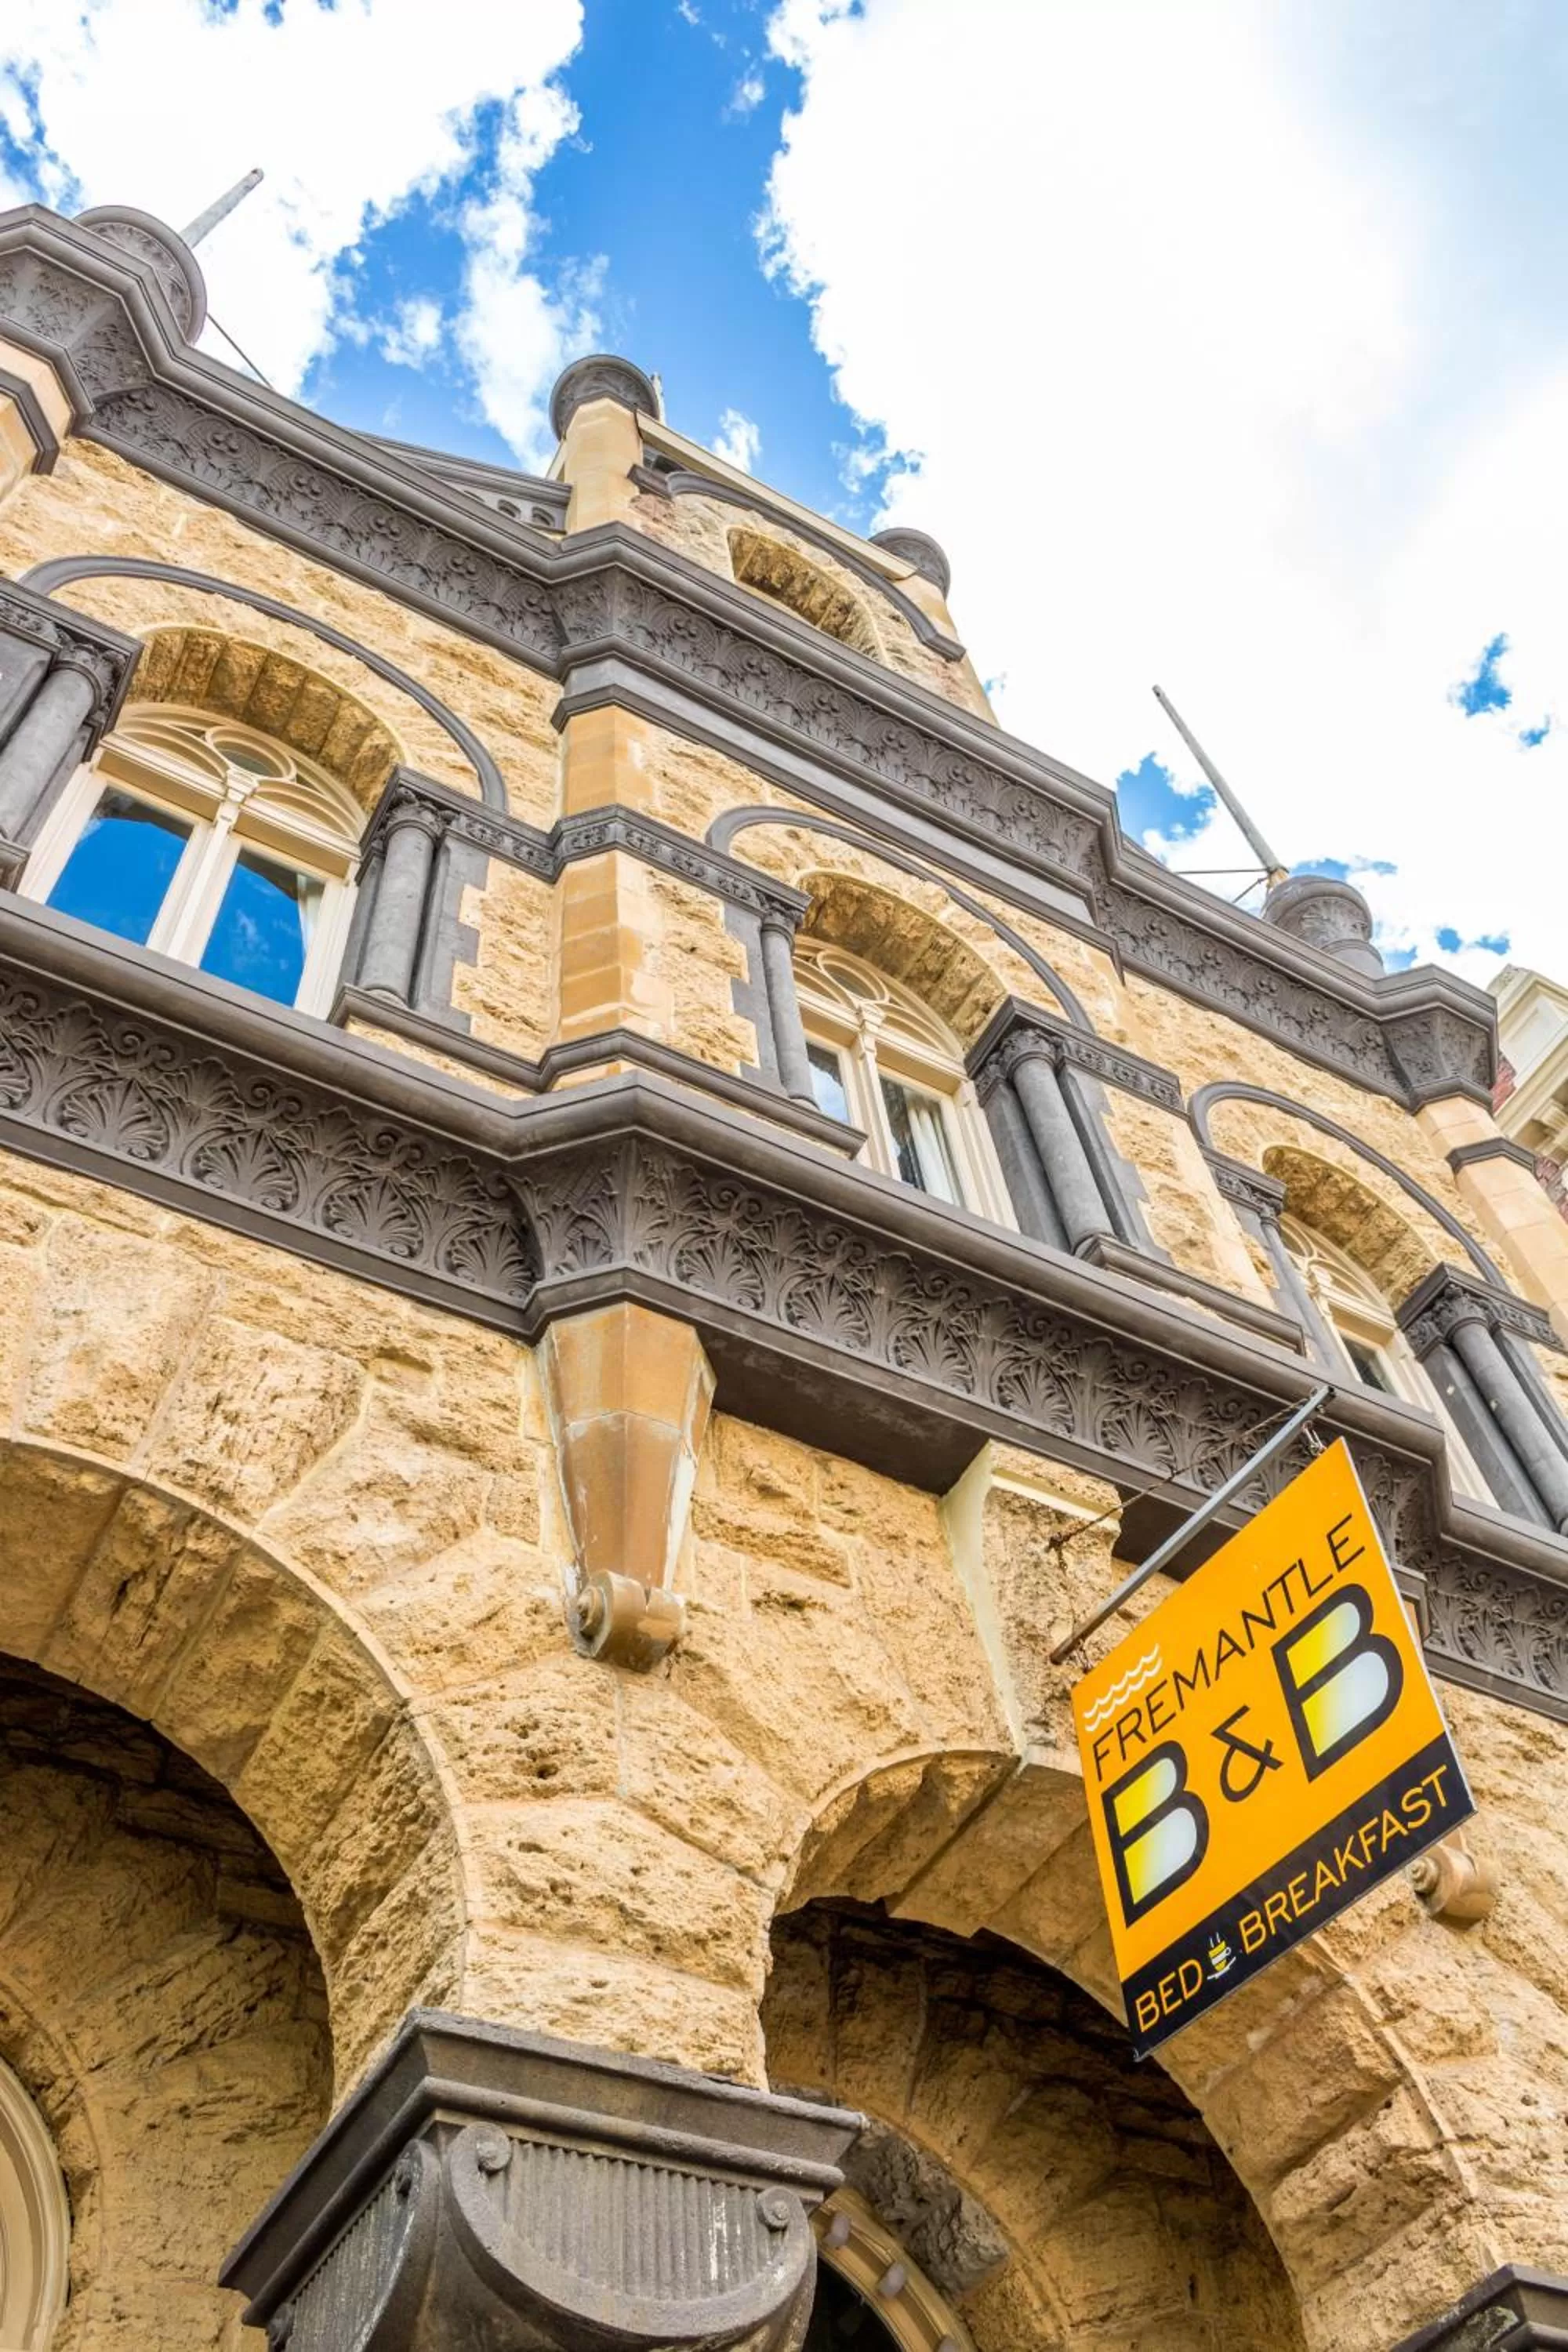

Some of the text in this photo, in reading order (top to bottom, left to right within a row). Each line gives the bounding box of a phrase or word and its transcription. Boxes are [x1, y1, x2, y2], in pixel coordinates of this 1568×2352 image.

[1091, 1514, 1365, 1781] FREMANTLE
[1134, 1766, 1449, 2034] BED BREAKFAST
